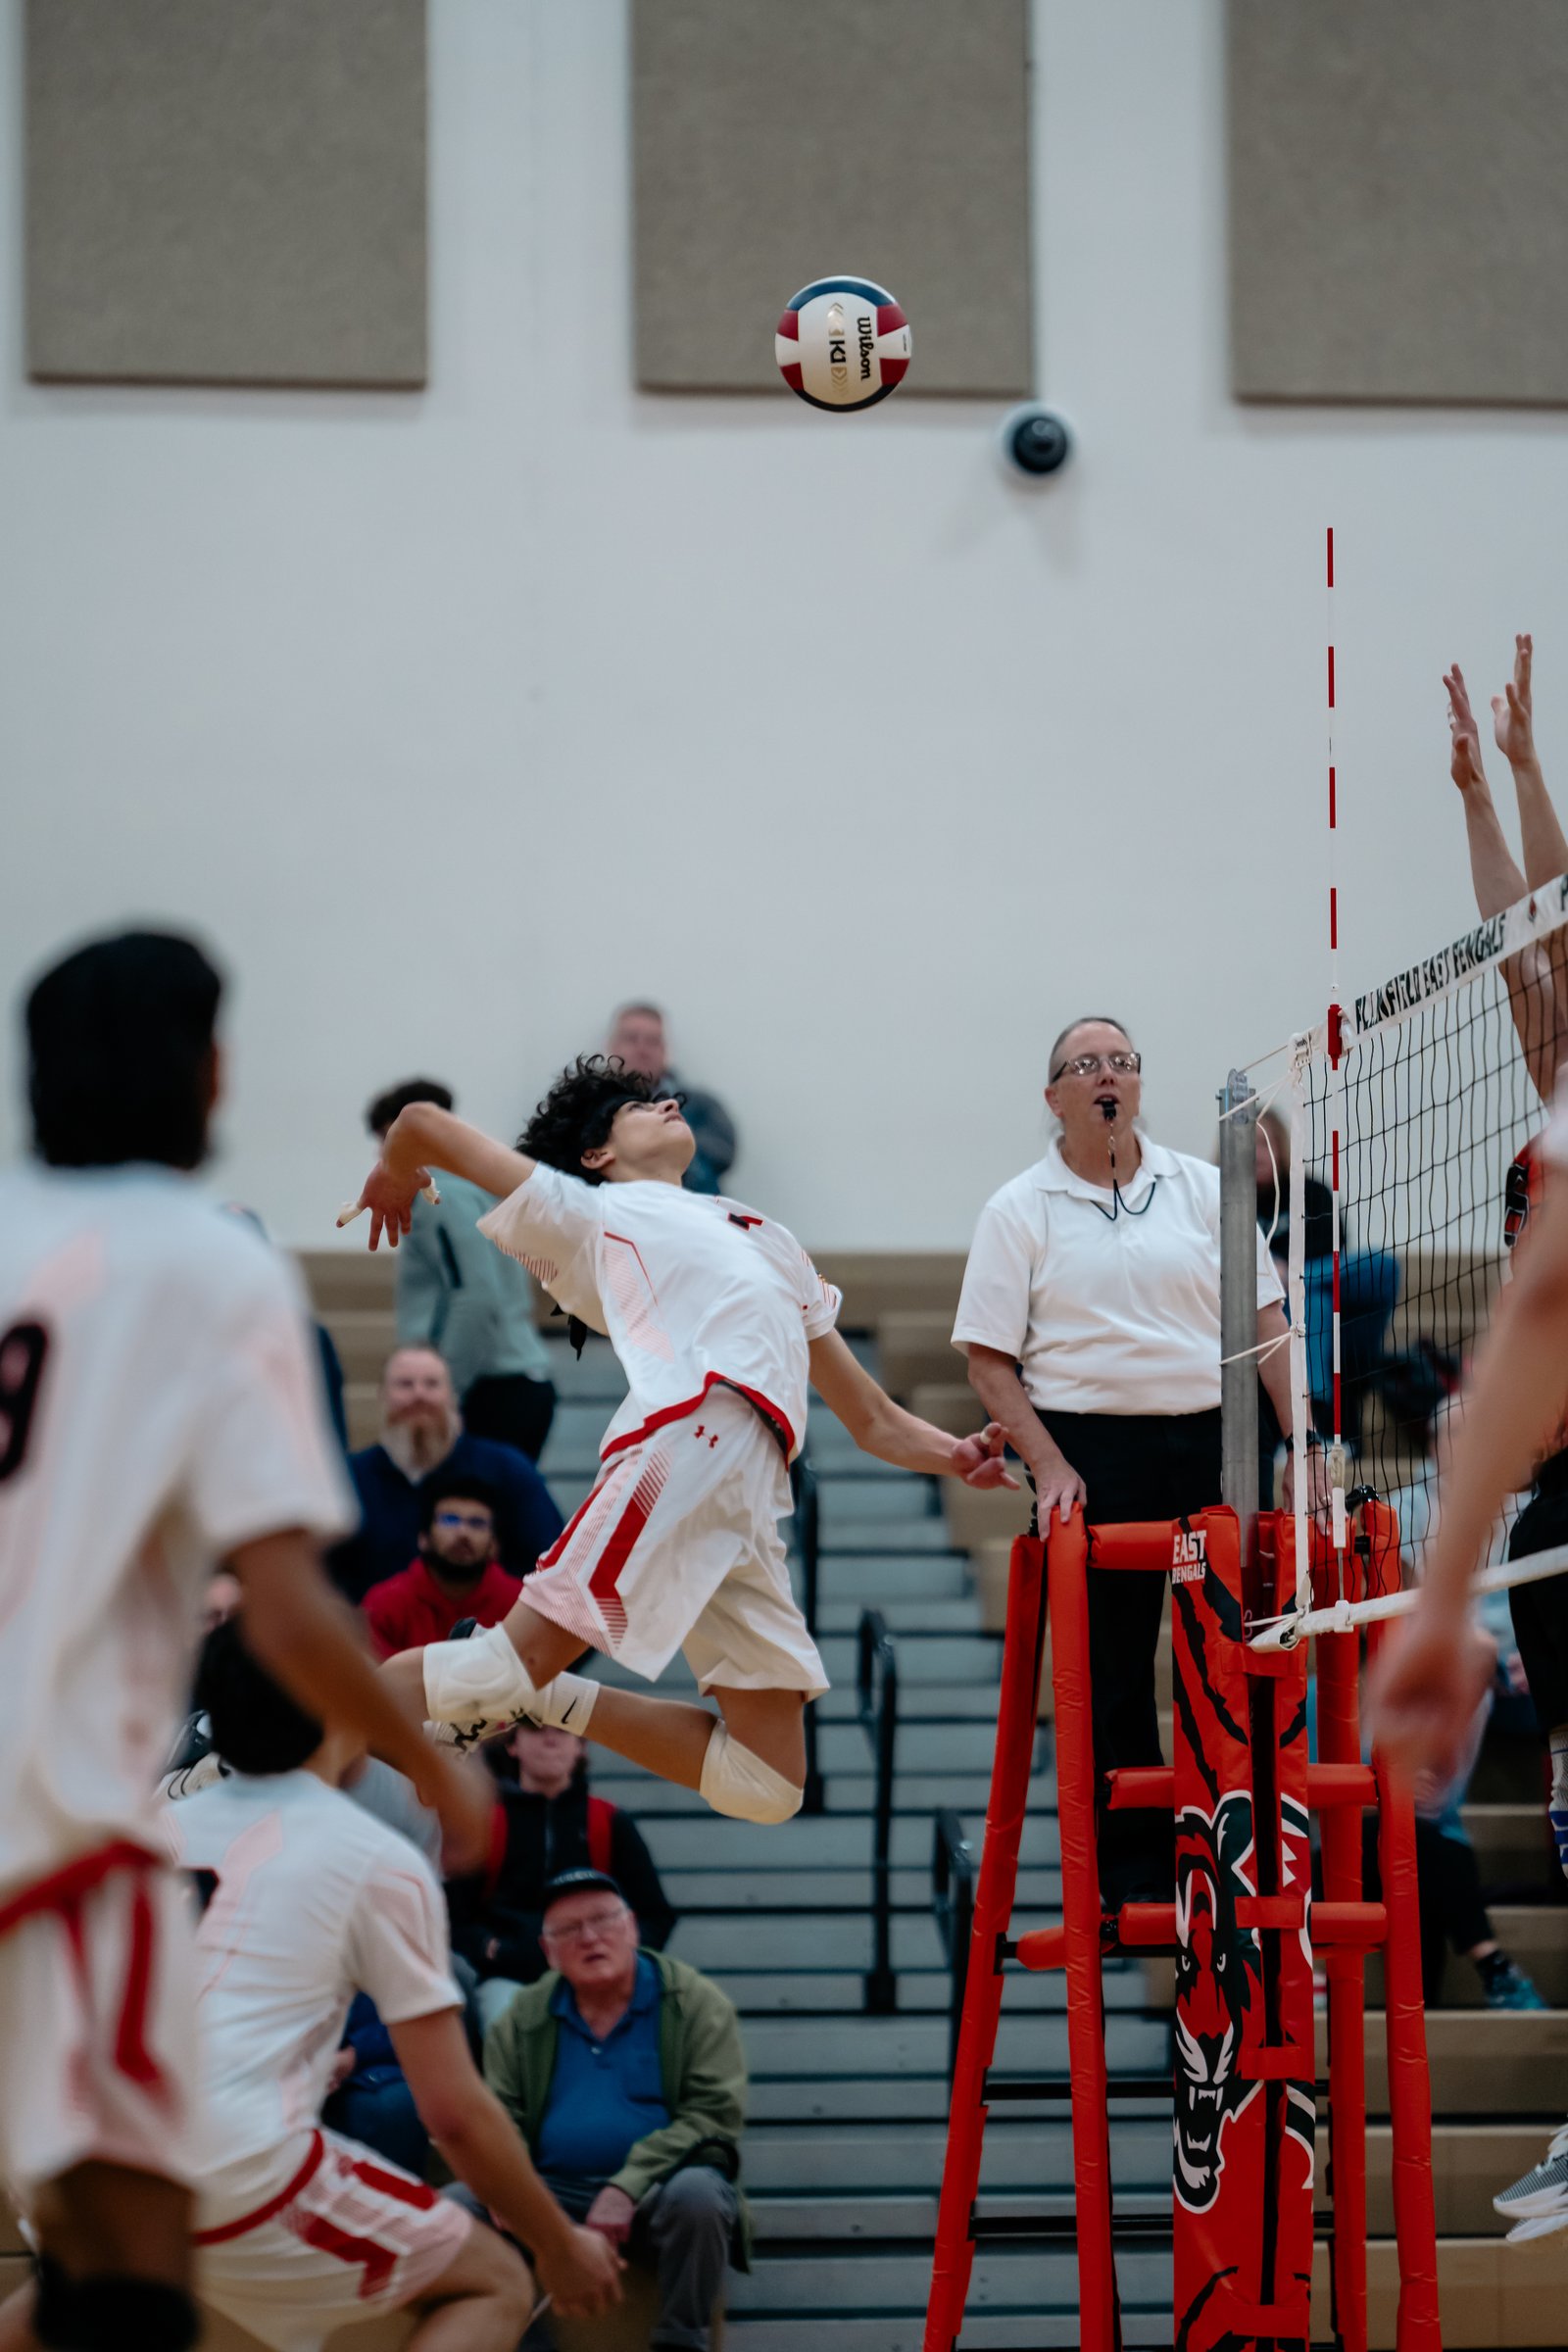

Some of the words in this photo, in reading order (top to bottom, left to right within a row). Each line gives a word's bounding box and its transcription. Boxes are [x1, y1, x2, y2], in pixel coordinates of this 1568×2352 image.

[857, 316, 873, 380] Wilson
[1422, 947, 1450, 998] EAST
[1173, 1530, 1206, 1565] EAST
[1172, 1562, 1206, 1585] BENGALS
